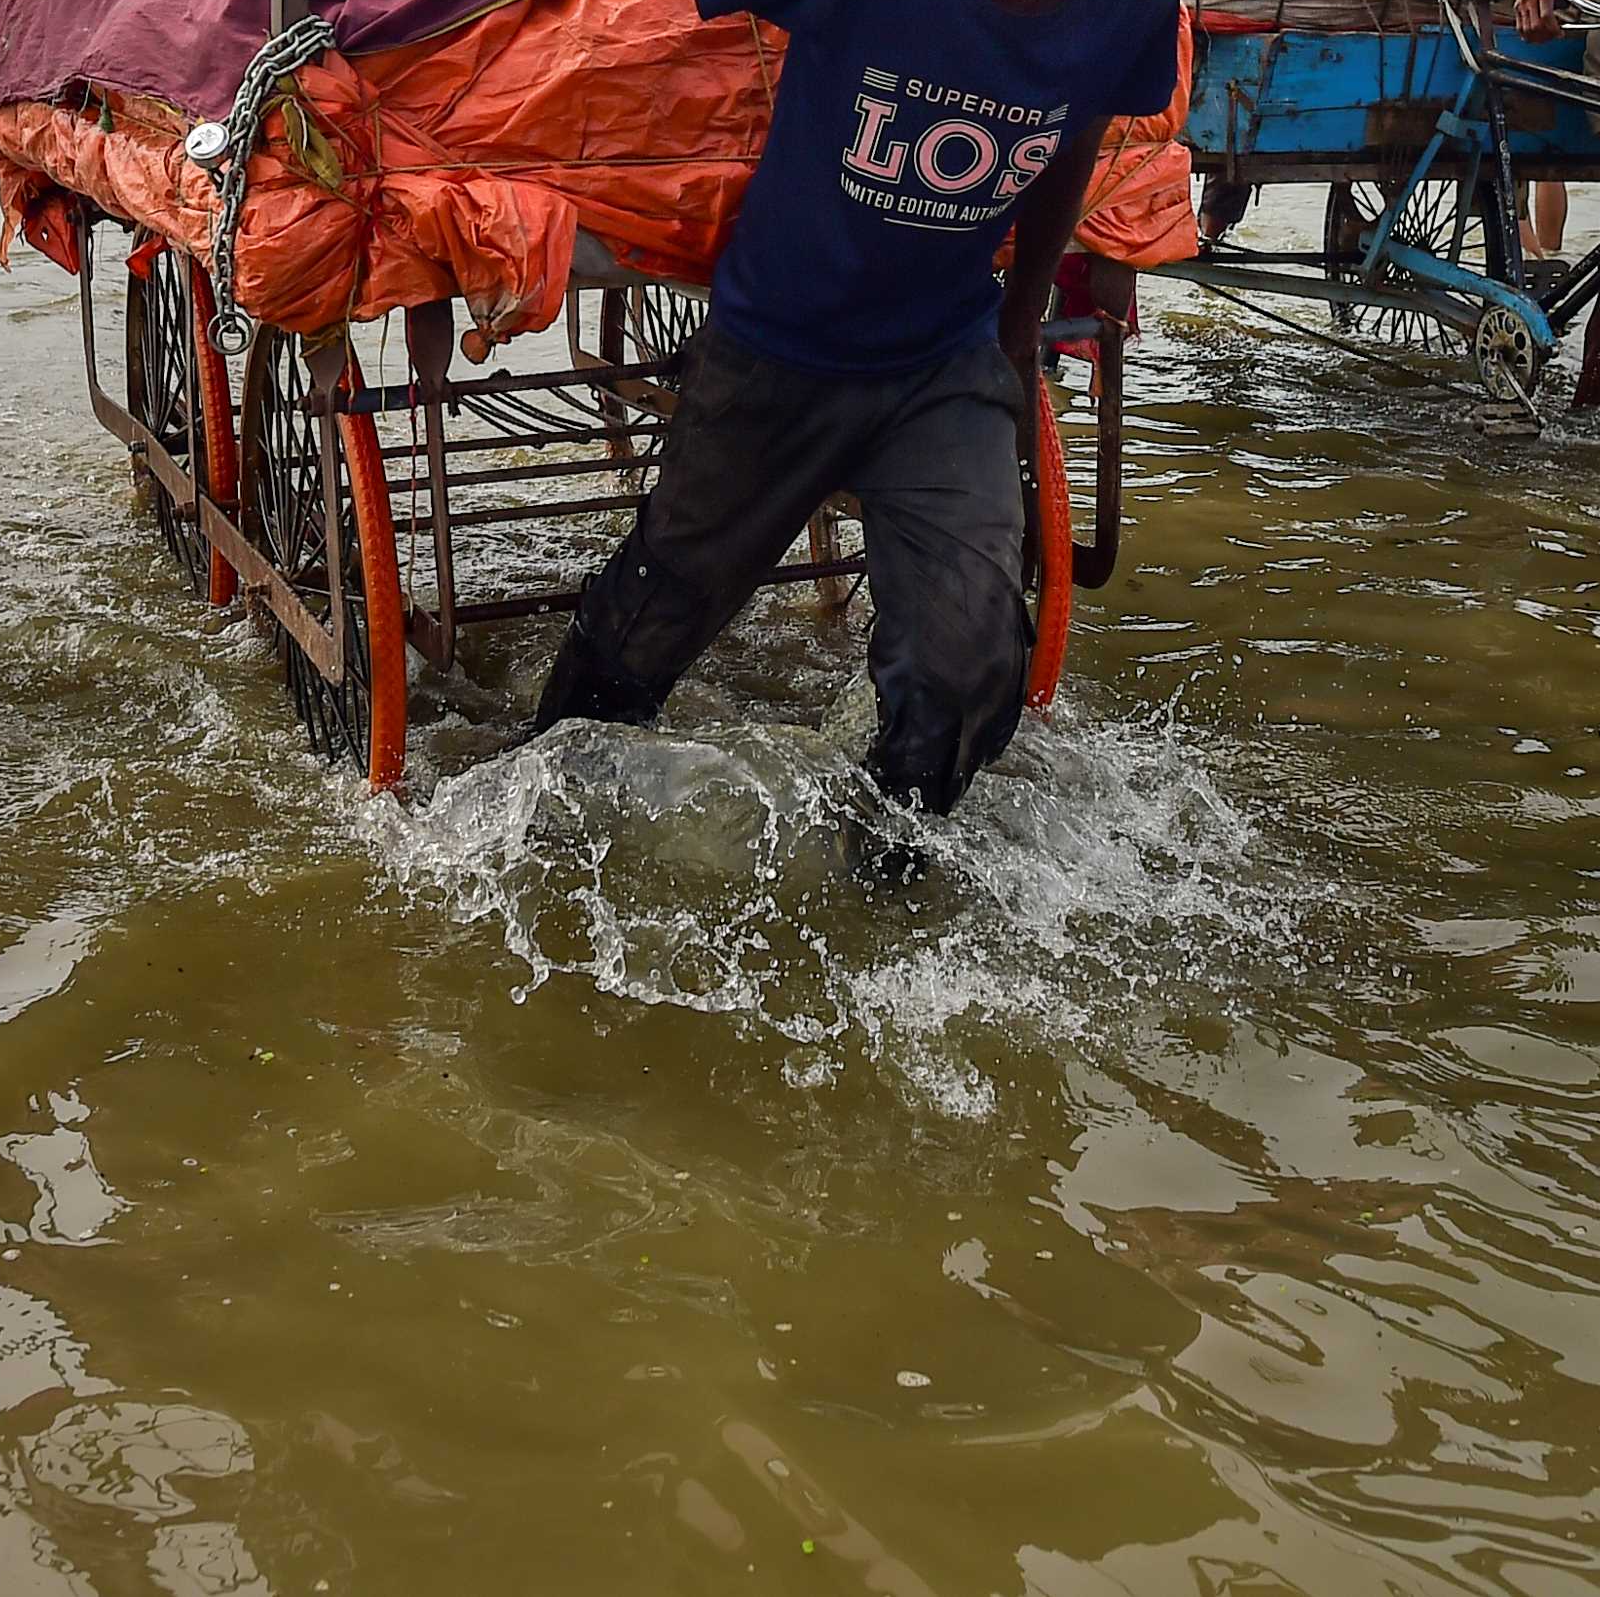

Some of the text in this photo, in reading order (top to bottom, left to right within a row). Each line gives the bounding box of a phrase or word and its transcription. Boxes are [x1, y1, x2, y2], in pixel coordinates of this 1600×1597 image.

[905, 78, 1043, 127] SUPERIOR
[842, 93, 1062, 199] LOS
[840, 171, 894, 211] LIMITED
[898, 195, 959, 220] EDITION
